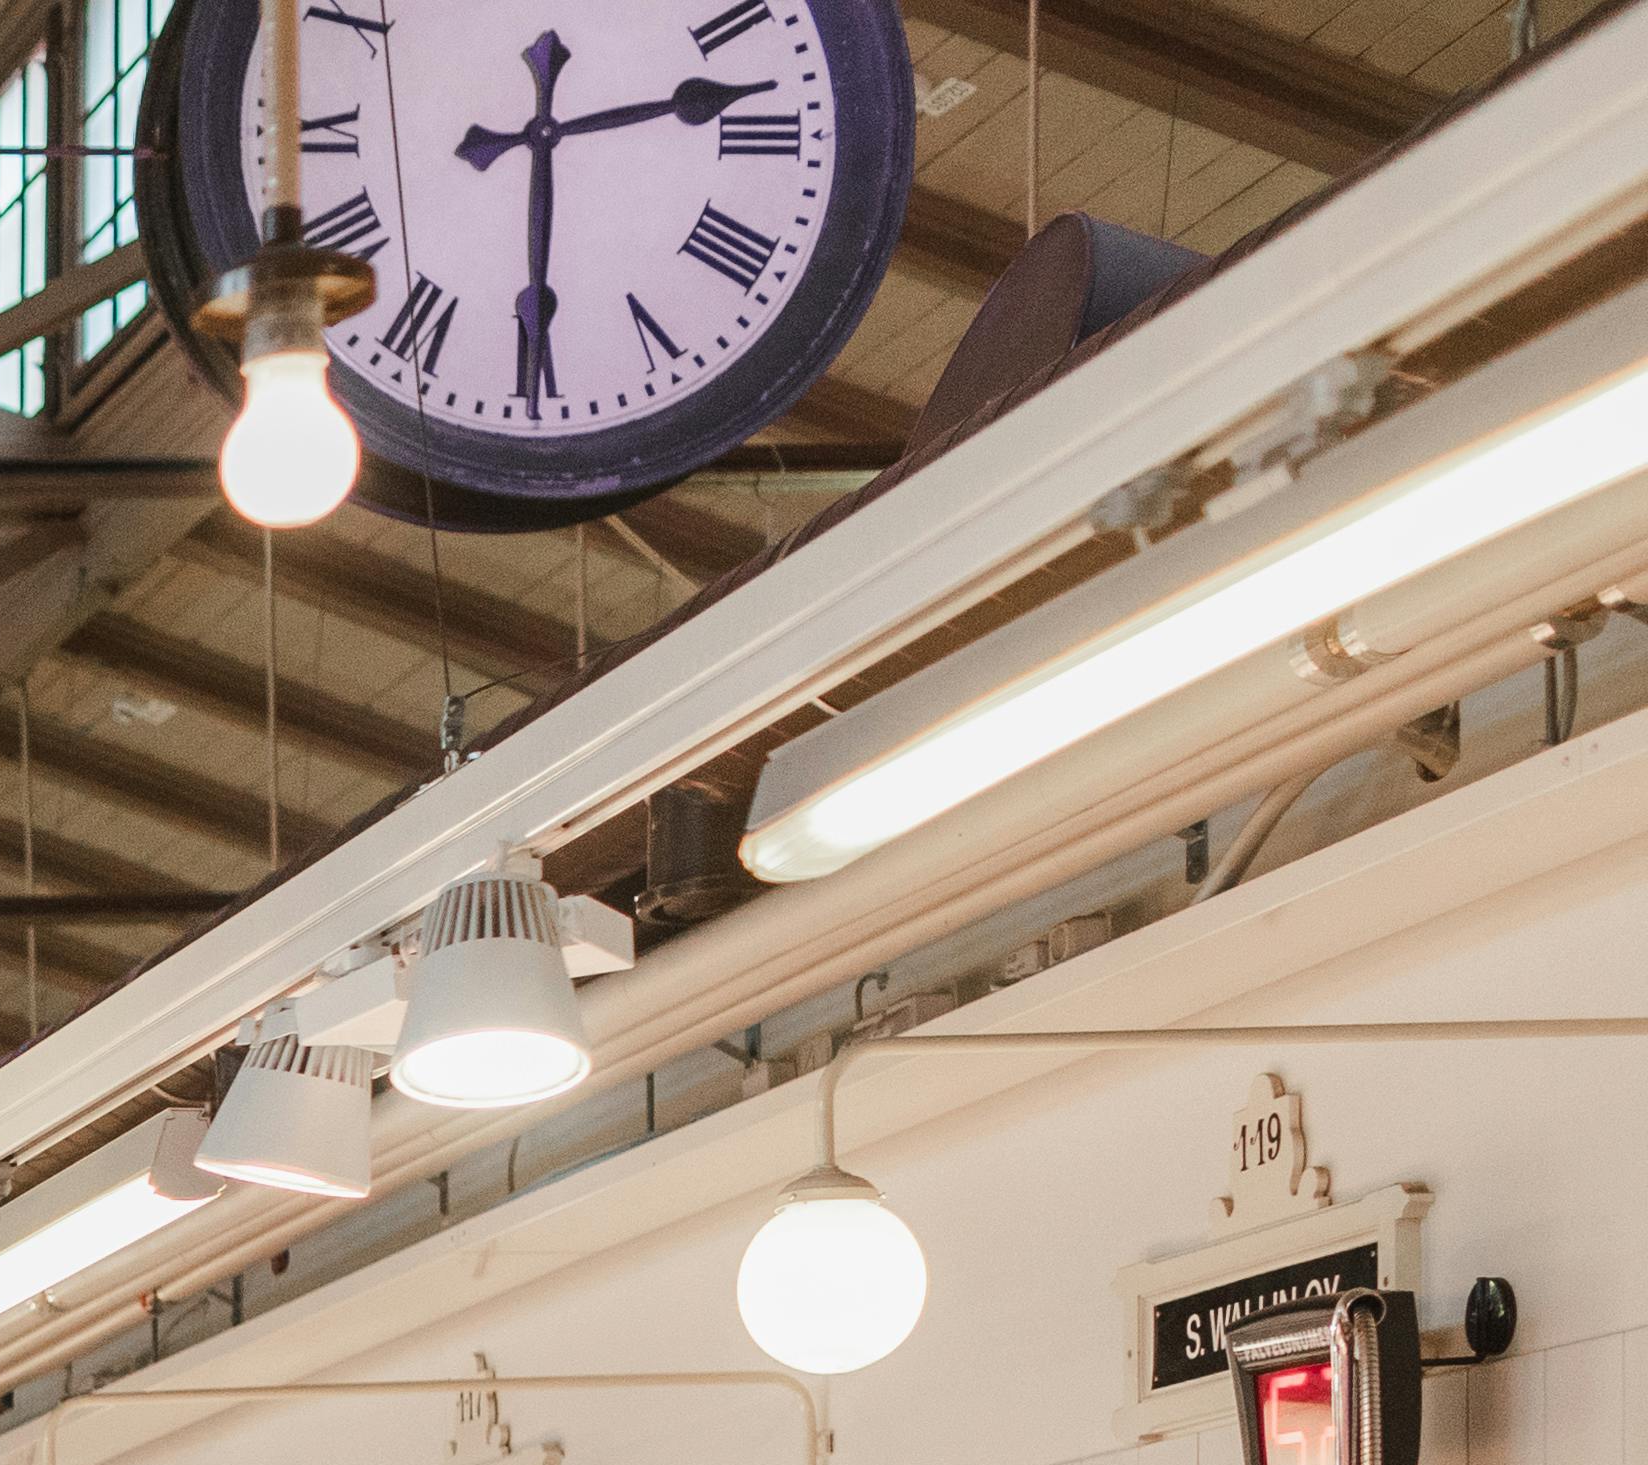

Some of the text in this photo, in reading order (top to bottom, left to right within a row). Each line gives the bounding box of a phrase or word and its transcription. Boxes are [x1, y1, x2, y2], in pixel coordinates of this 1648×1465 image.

[719, 110, 802, 160] III
[625, 292, 689, 374] V
[1185, 1312, 1206, 1360] S.
